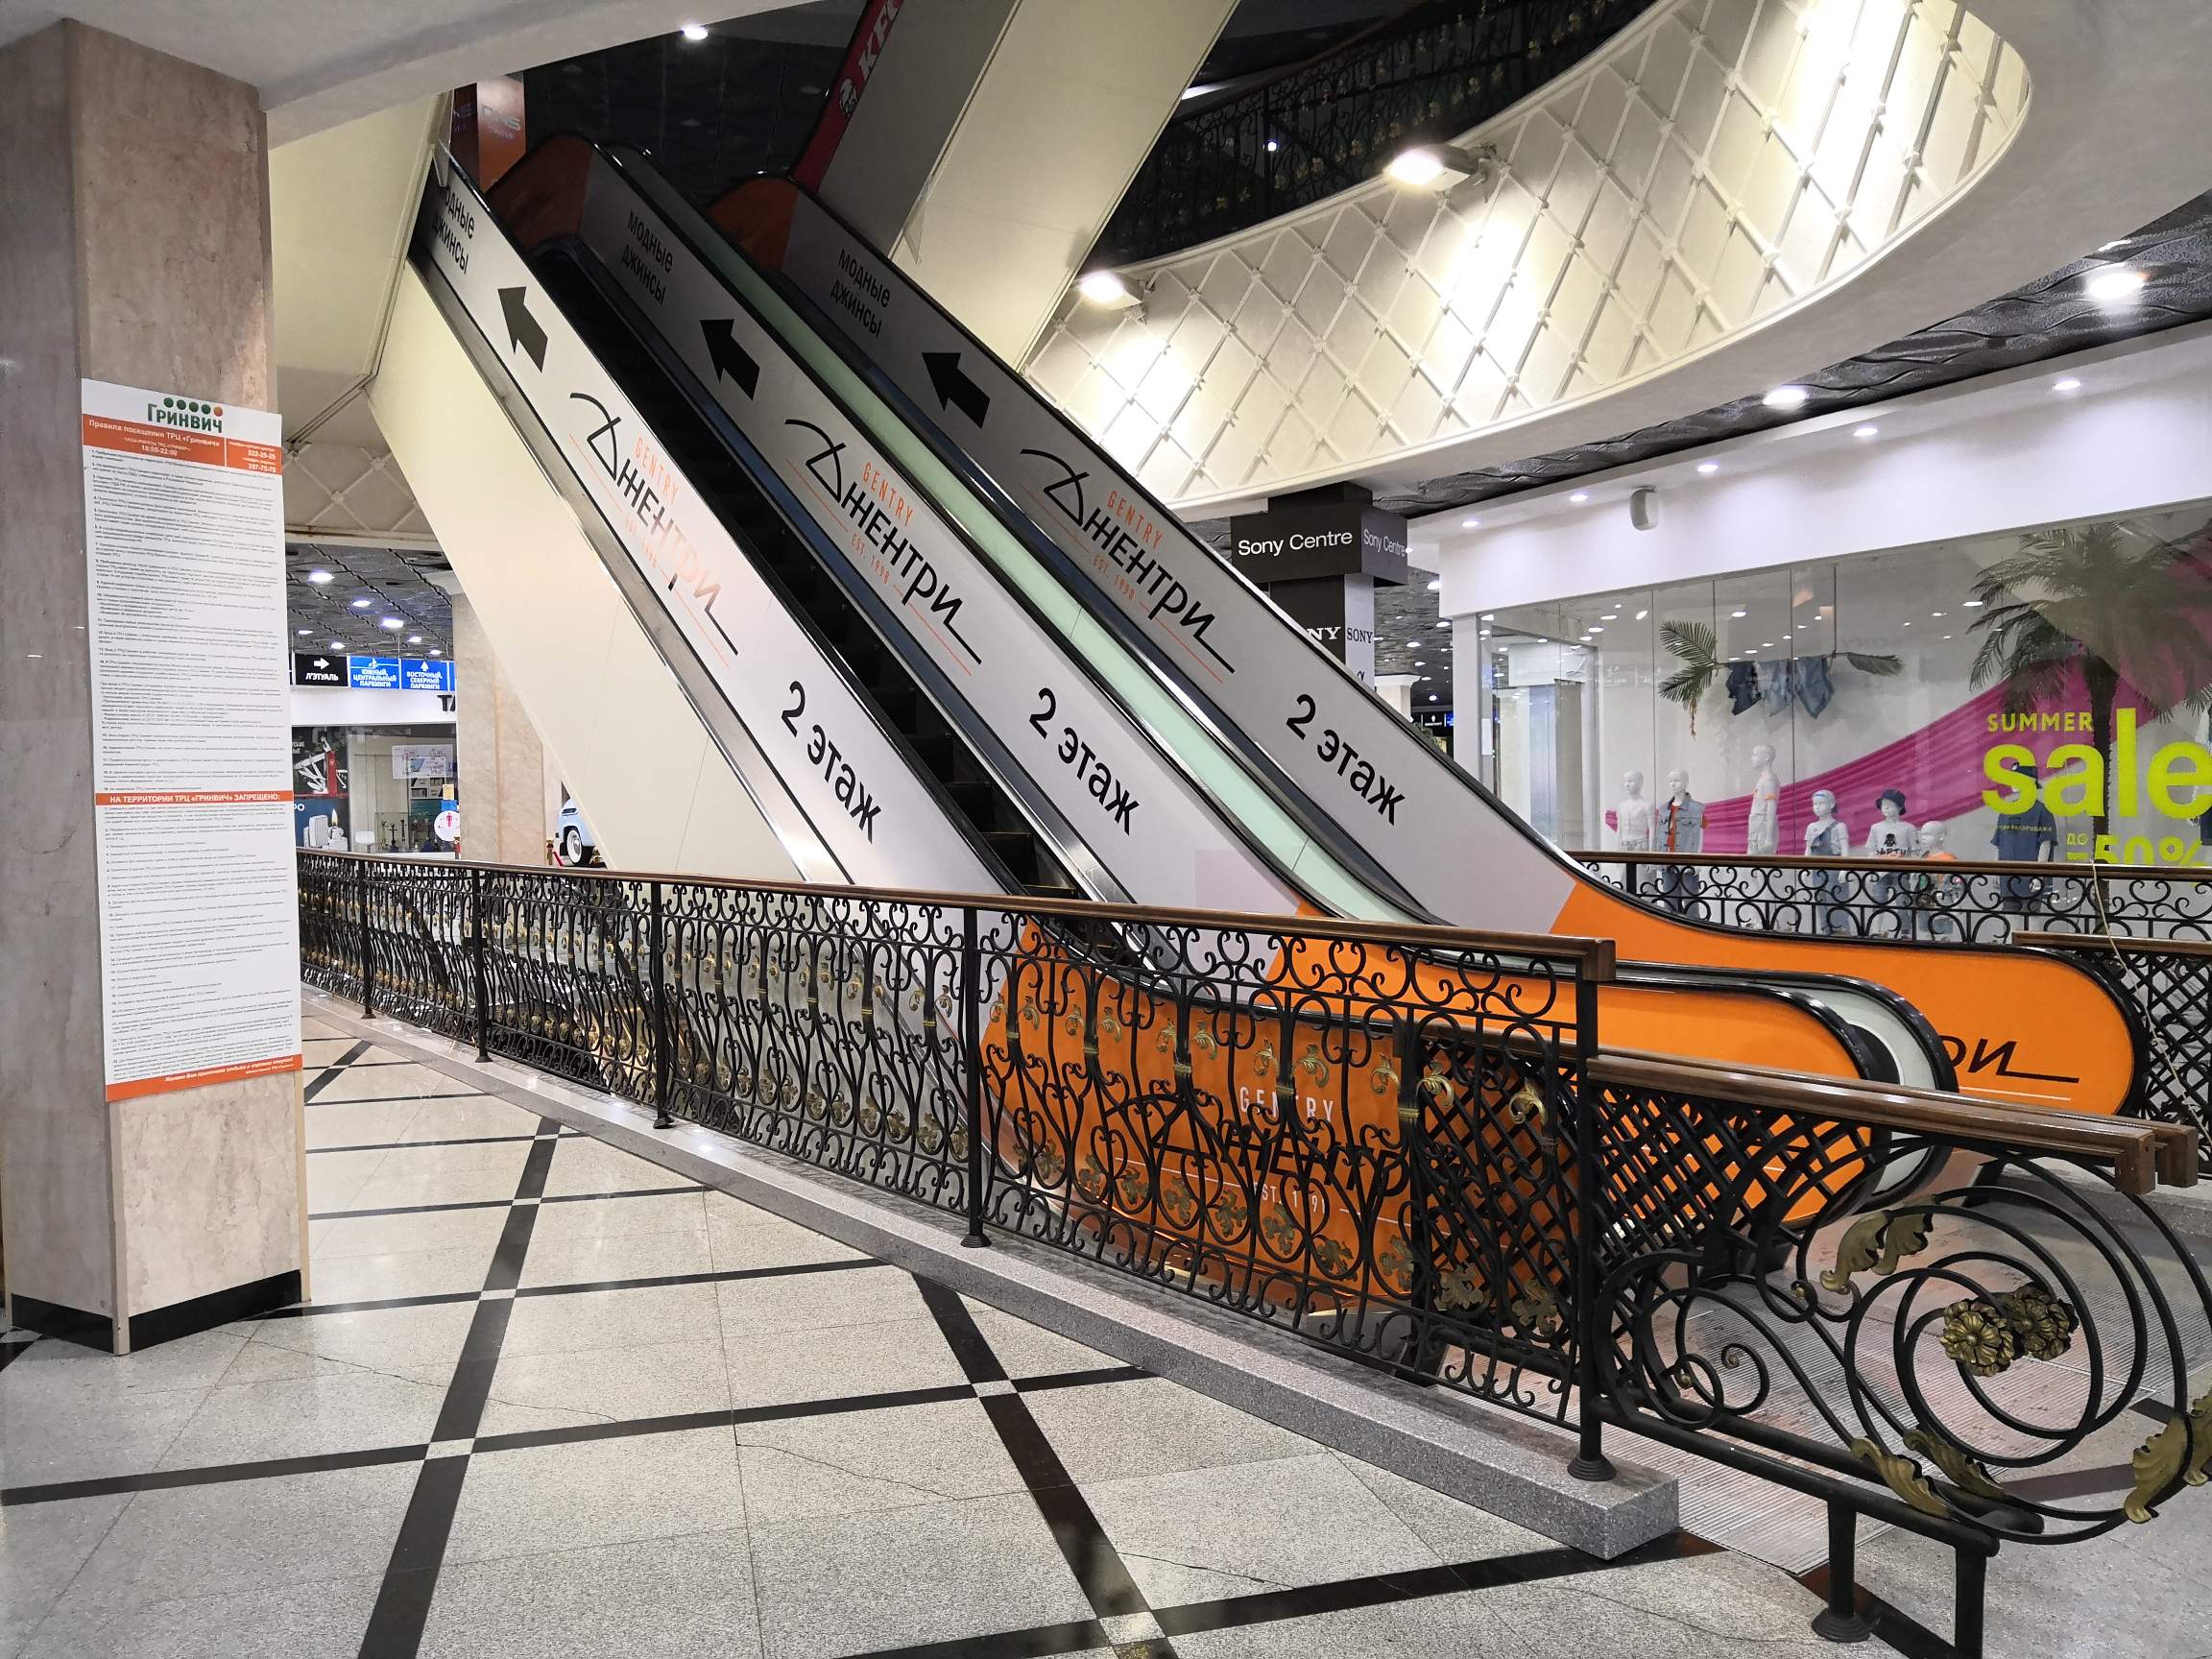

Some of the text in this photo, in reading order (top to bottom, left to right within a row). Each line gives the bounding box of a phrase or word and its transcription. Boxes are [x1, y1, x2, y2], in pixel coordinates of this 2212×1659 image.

[88, 419, 122, 431] Правила
[167, 432, 181, 442] ТРЦ
[636, 437, 678, 505] GENTRY
[863, 461, 913, 526] GENTRY
[1108, 491, 1163, 549] GENTRY
[1238, 531, 1353, 556] Sony Centre
[1363, 528, 1406, 557] Sony Centre
[1347, 627, 1373, 644] SONY
[1986, 711, 2093, 733] SUMMER
[781, 681, 881, 845] 2 этаж
[1029, 687, 1140, 836] 2 этаж
[1286, 694, 1406, 826] 2 этаж
[1982, 708, 2212, 819] sale
[123, 795, 173, 804] ТЕРРИТОРИИ
[175, 795, 191, 804] ТРЦ
[191, 794, 233, 803] «ГРИНВИЧ»
[234, 793, 280, 802] ЗАПРЕЩЕНО:
[1239, 1086, 1334, 1122] GENRY
